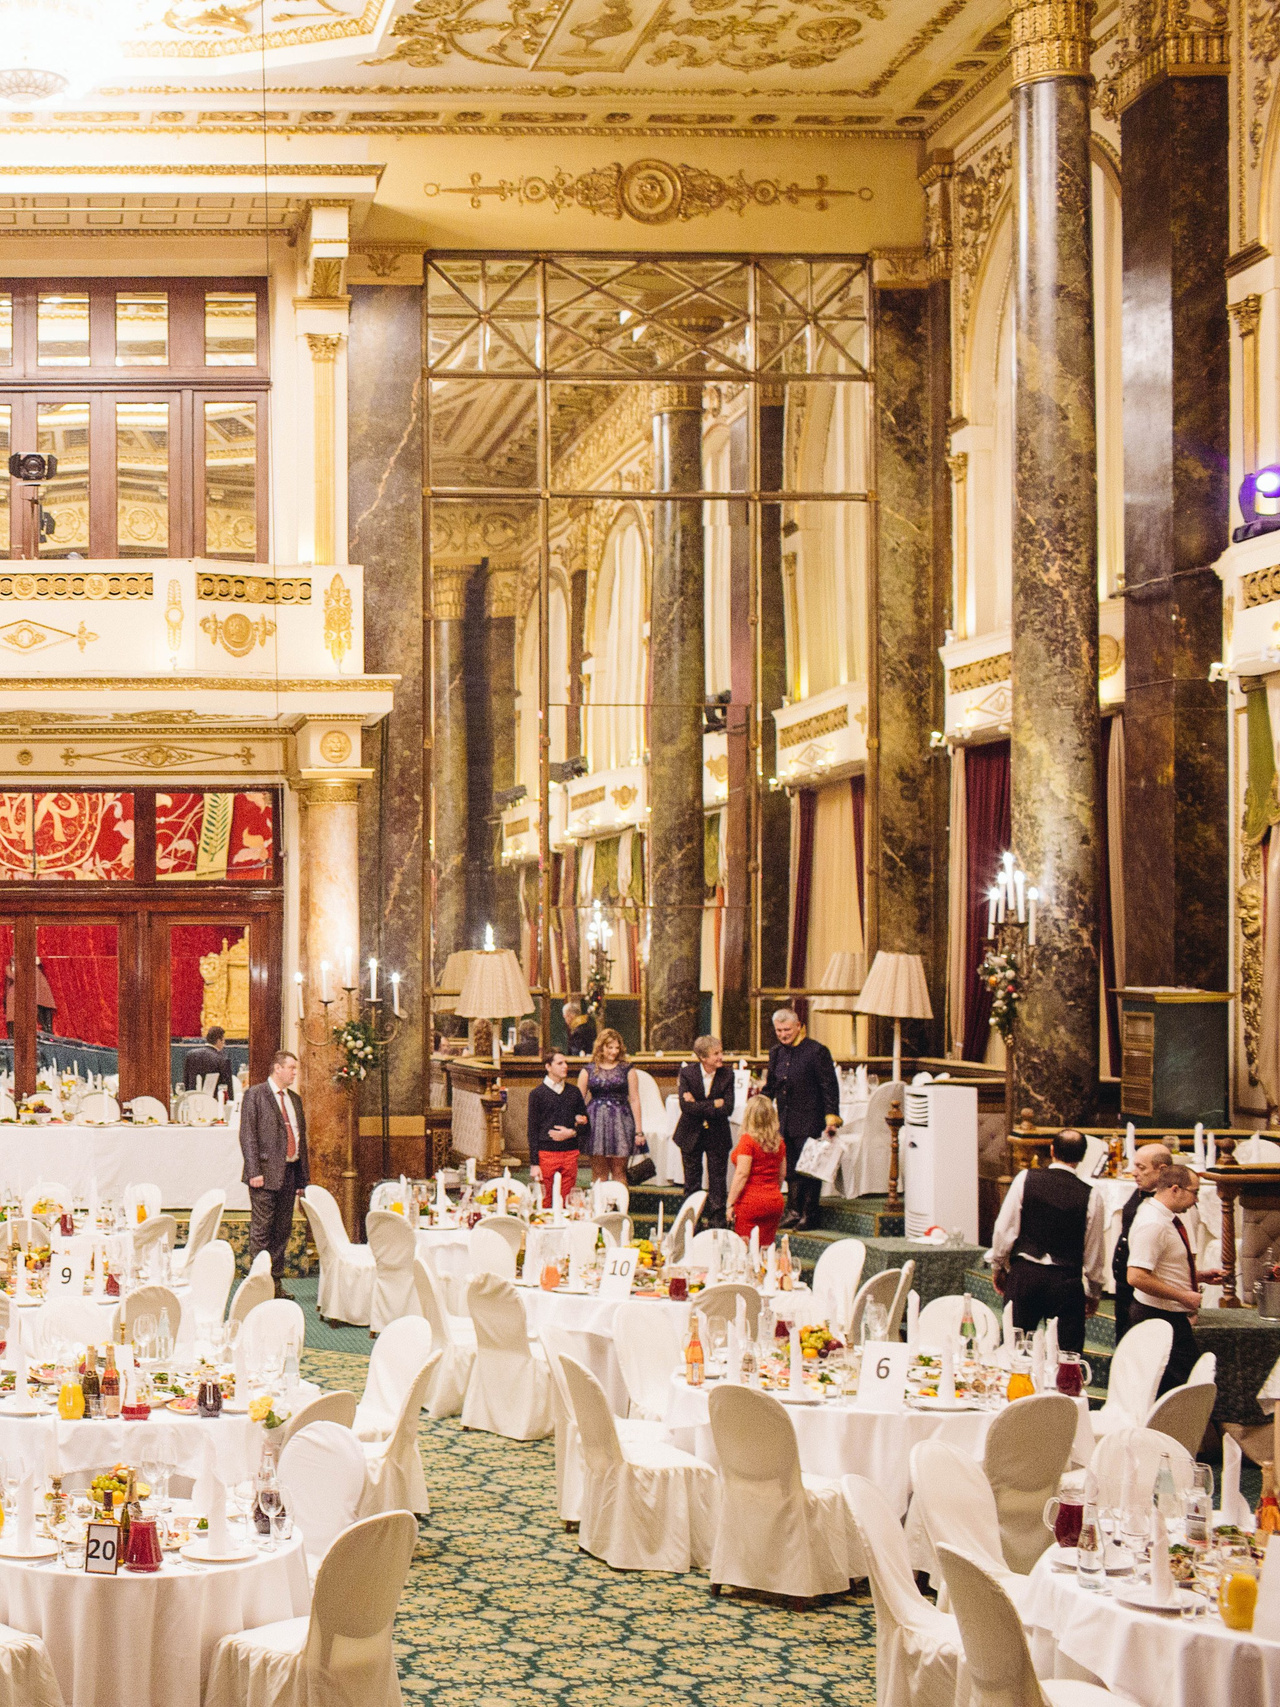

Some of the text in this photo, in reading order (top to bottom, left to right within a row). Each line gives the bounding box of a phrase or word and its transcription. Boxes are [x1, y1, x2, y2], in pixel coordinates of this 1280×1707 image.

[61, 1267, 73, 1285] 9
[609, 1260, 631, 1277] 10
[876, 1357, 891, 1379] 6
[87, 1538, 116, 1561] 20
